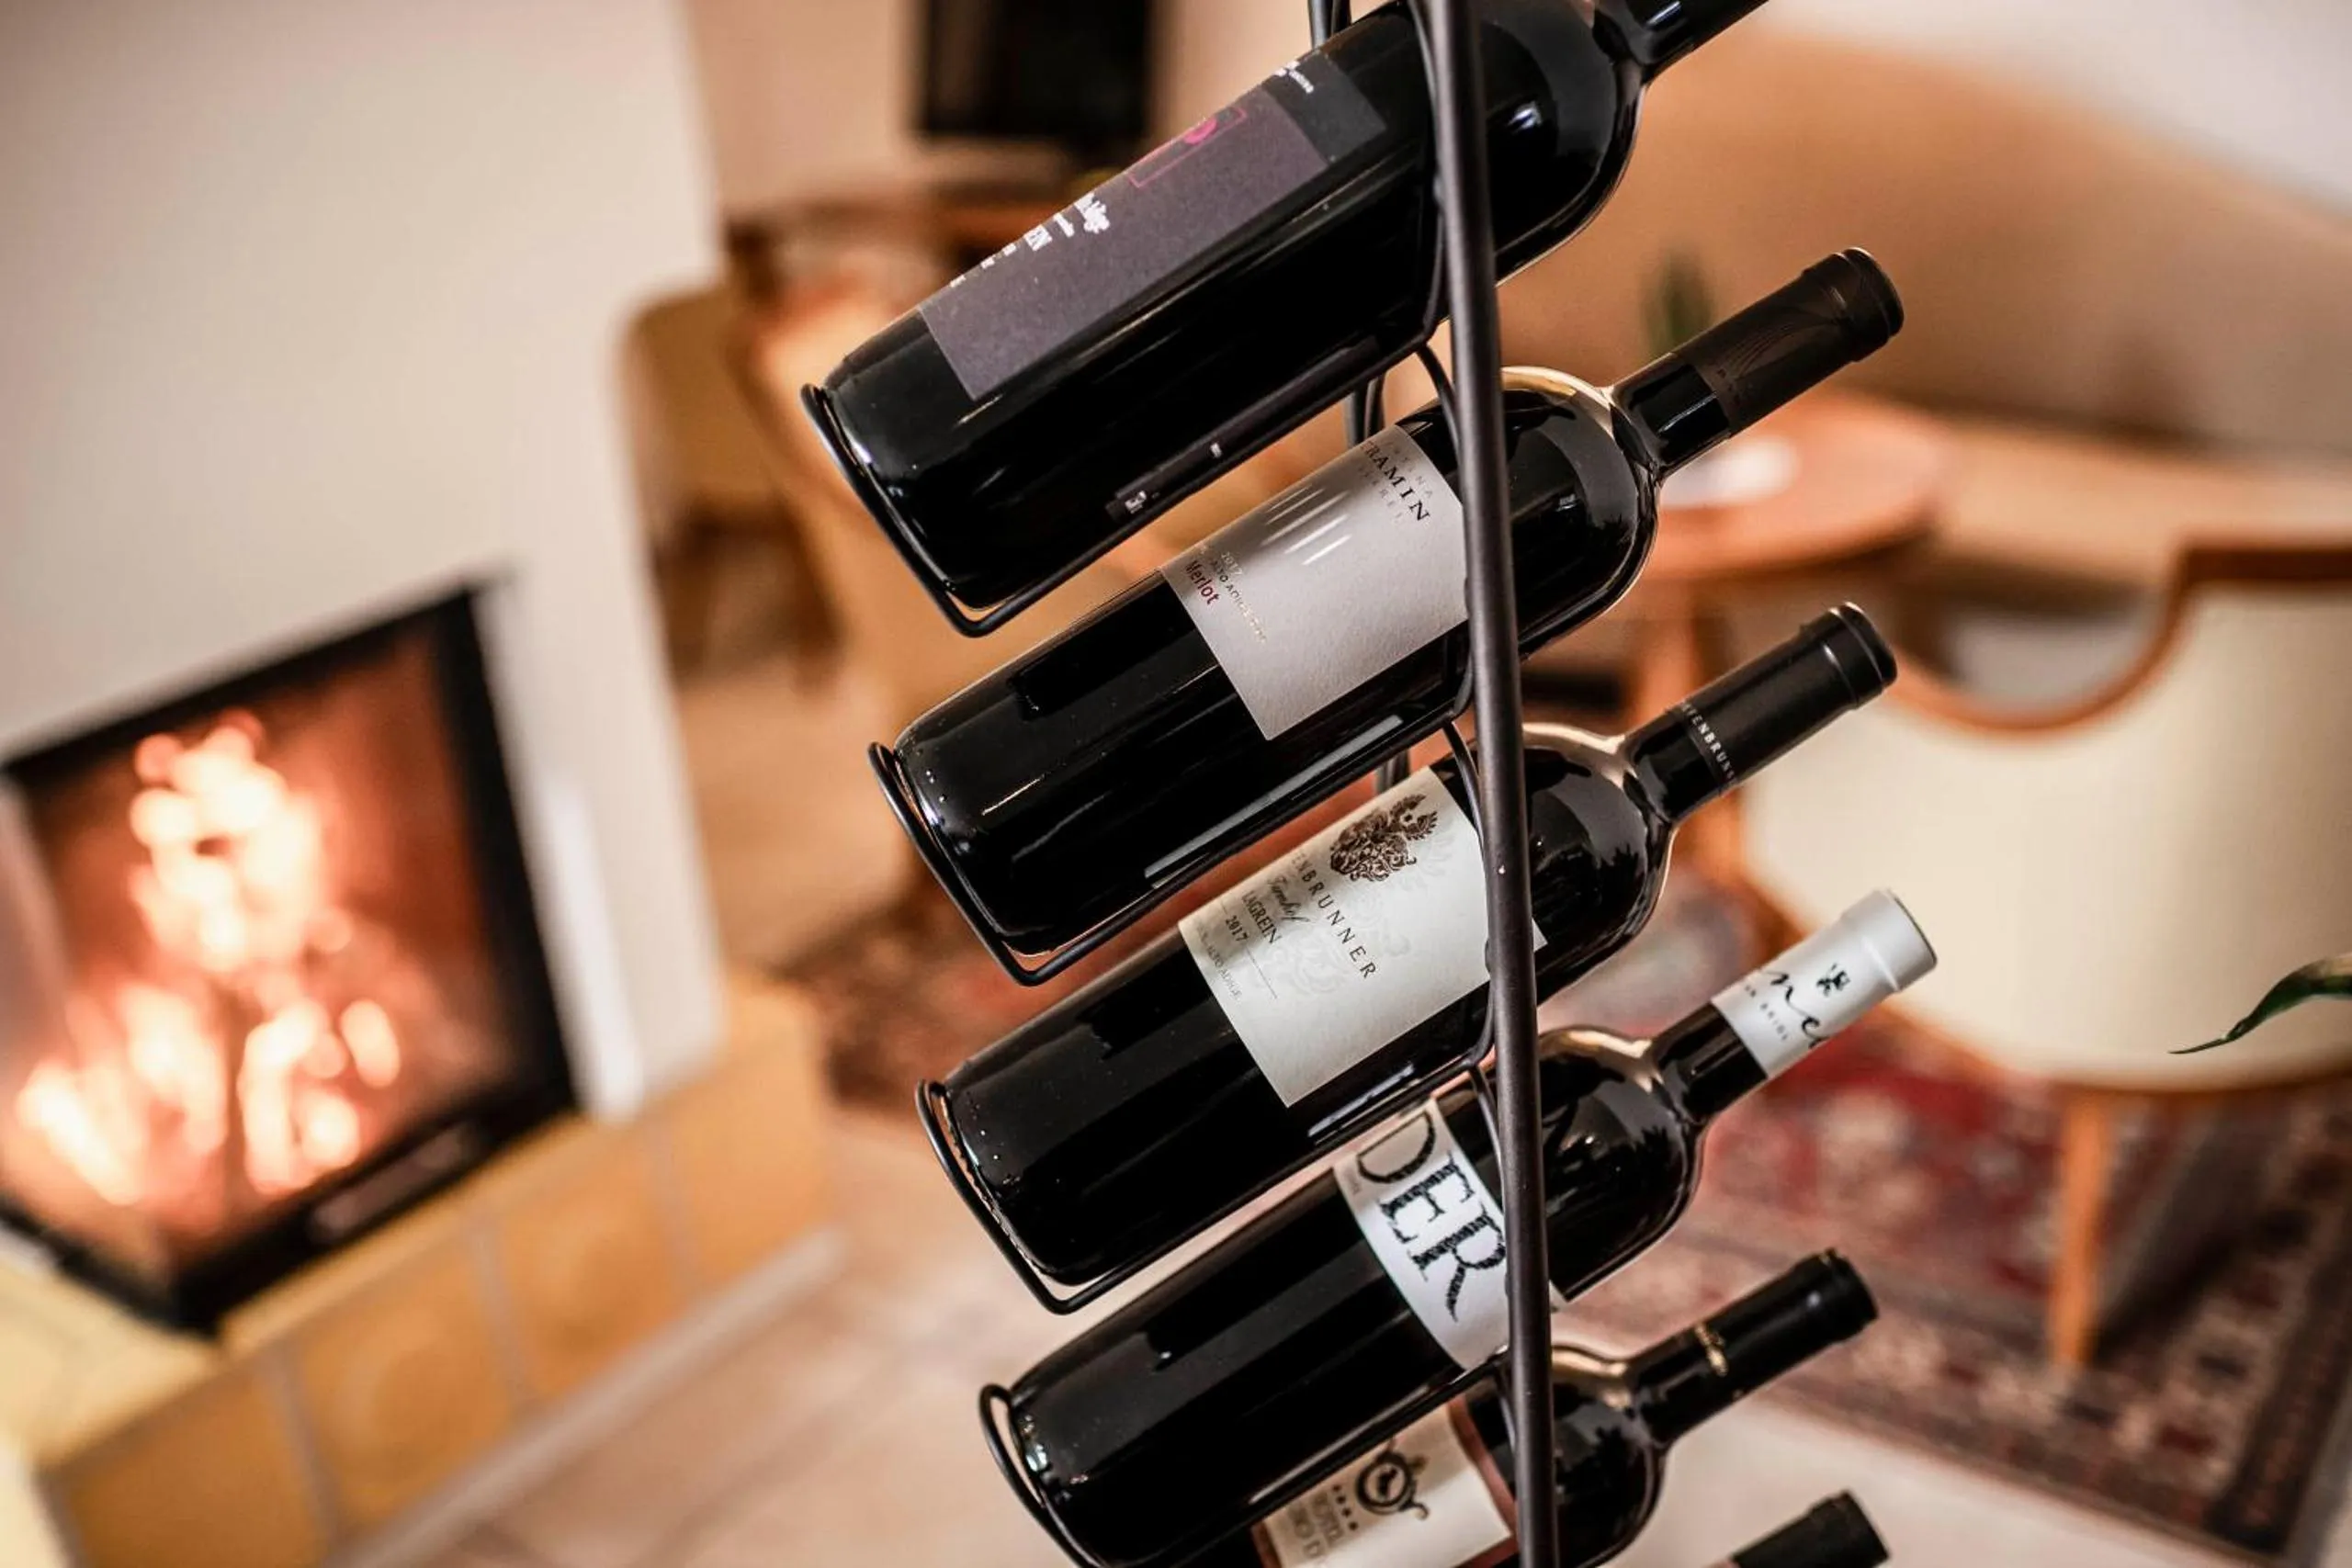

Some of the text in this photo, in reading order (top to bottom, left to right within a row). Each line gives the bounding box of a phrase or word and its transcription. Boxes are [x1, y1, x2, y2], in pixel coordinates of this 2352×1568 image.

[1184, 558, 1222, 605] Merlot
[1224, 914, 1249, 944] 2017
[1240, 889, 1283, 944] LAGREIN
